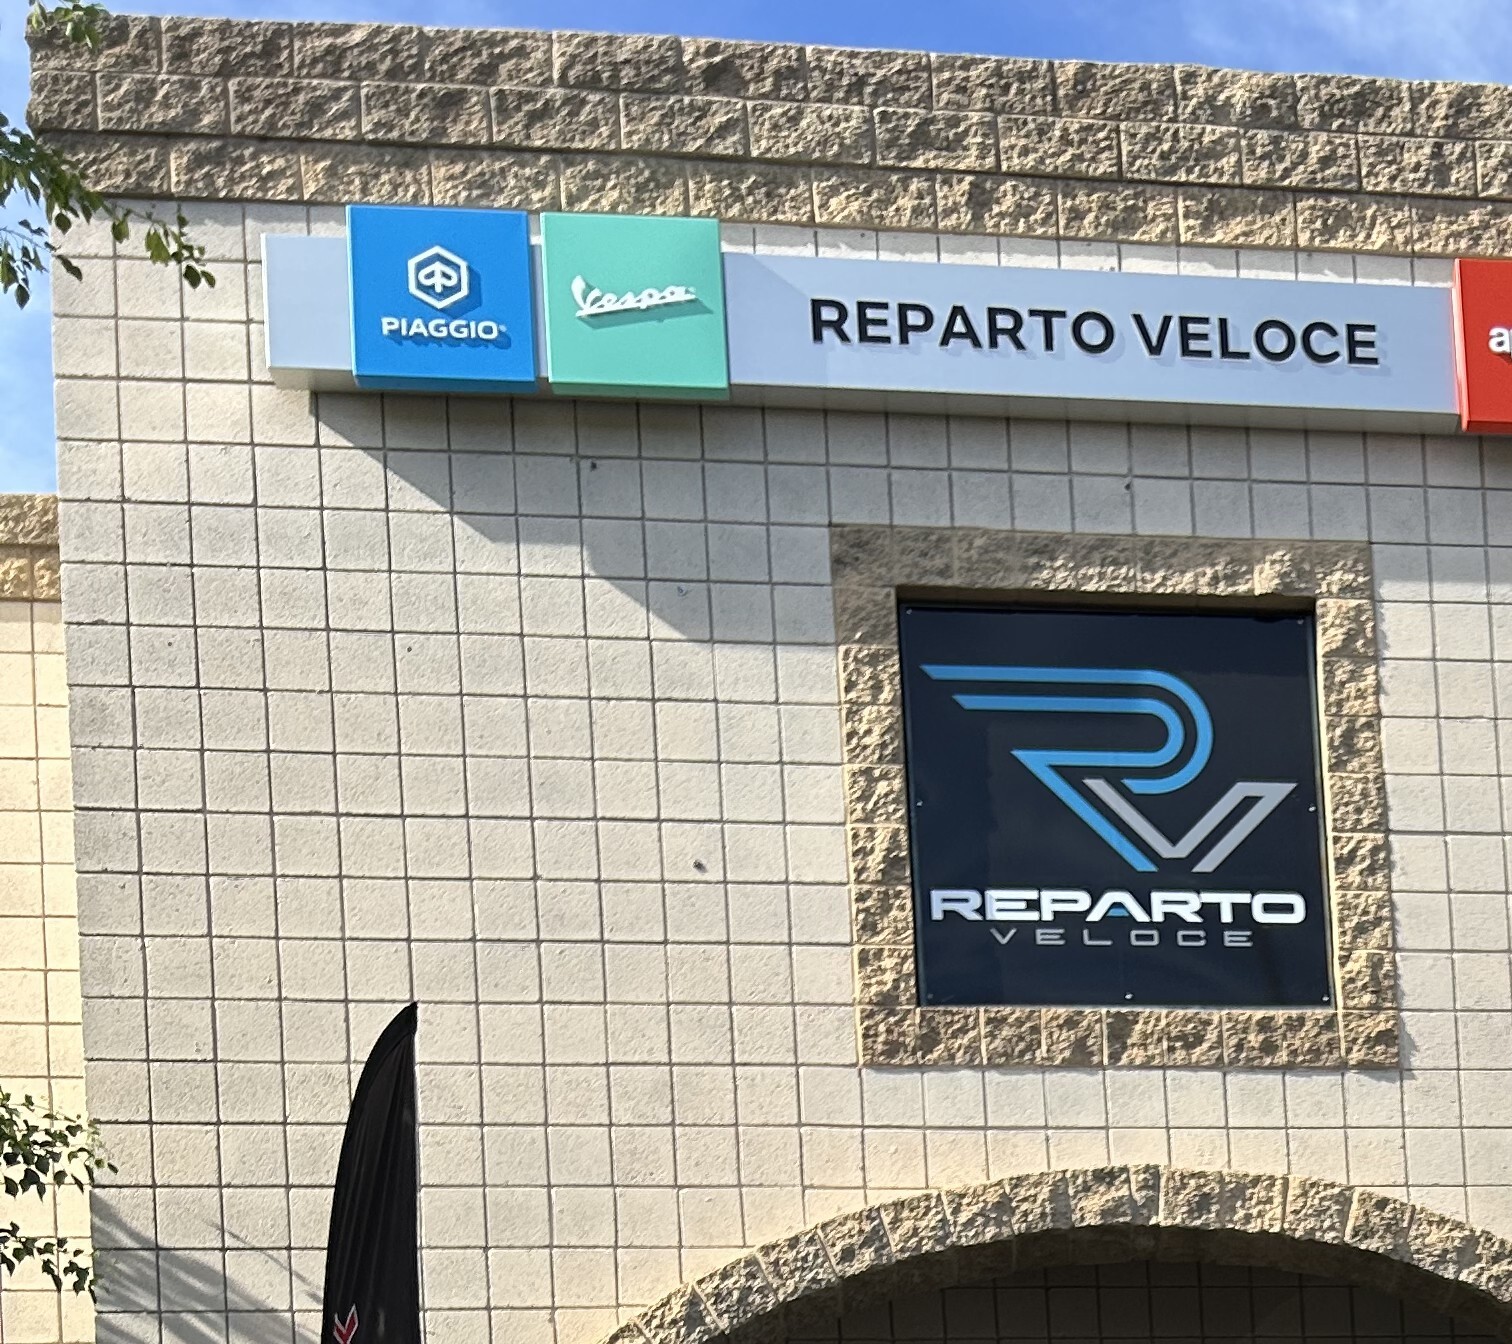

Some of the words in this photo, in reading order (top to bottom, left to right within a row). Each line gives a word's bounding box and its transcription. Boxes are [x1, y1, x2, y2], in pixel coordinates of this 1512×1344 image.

[571, 275, 696, 318] Vespa
[381, 315, 500, 341] PIAGGIO
[810, 298, 1114, 358] REPARTO
[1130, 313, 1381, 366] VELOCE
[930, 887, 1306, 924] REPARTO
[989, 927, 1254, 948] VELOCE
